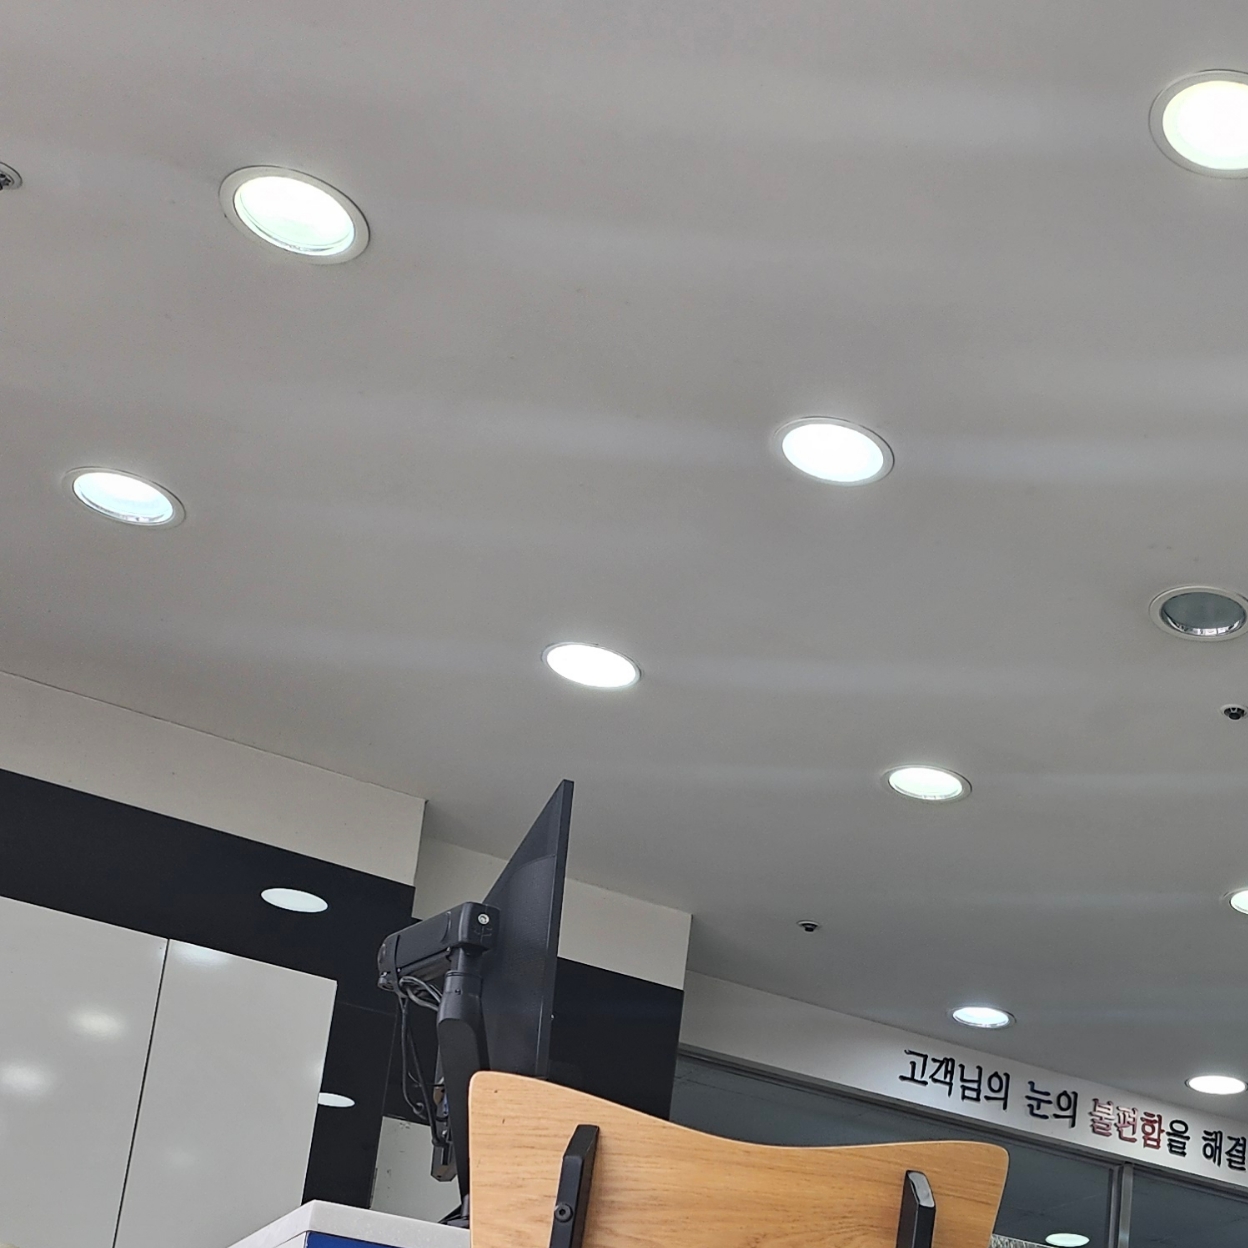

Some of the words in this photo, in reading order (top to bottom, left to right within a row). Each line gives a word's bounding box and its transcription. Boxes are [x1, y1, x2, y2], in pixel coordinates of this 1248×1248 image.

[899, 1050, 1010, 1110] 고객님의
[1024, 1081, 1078, 1128] 눈의
[1089, 1098, 1190, 1157] 불편함을
